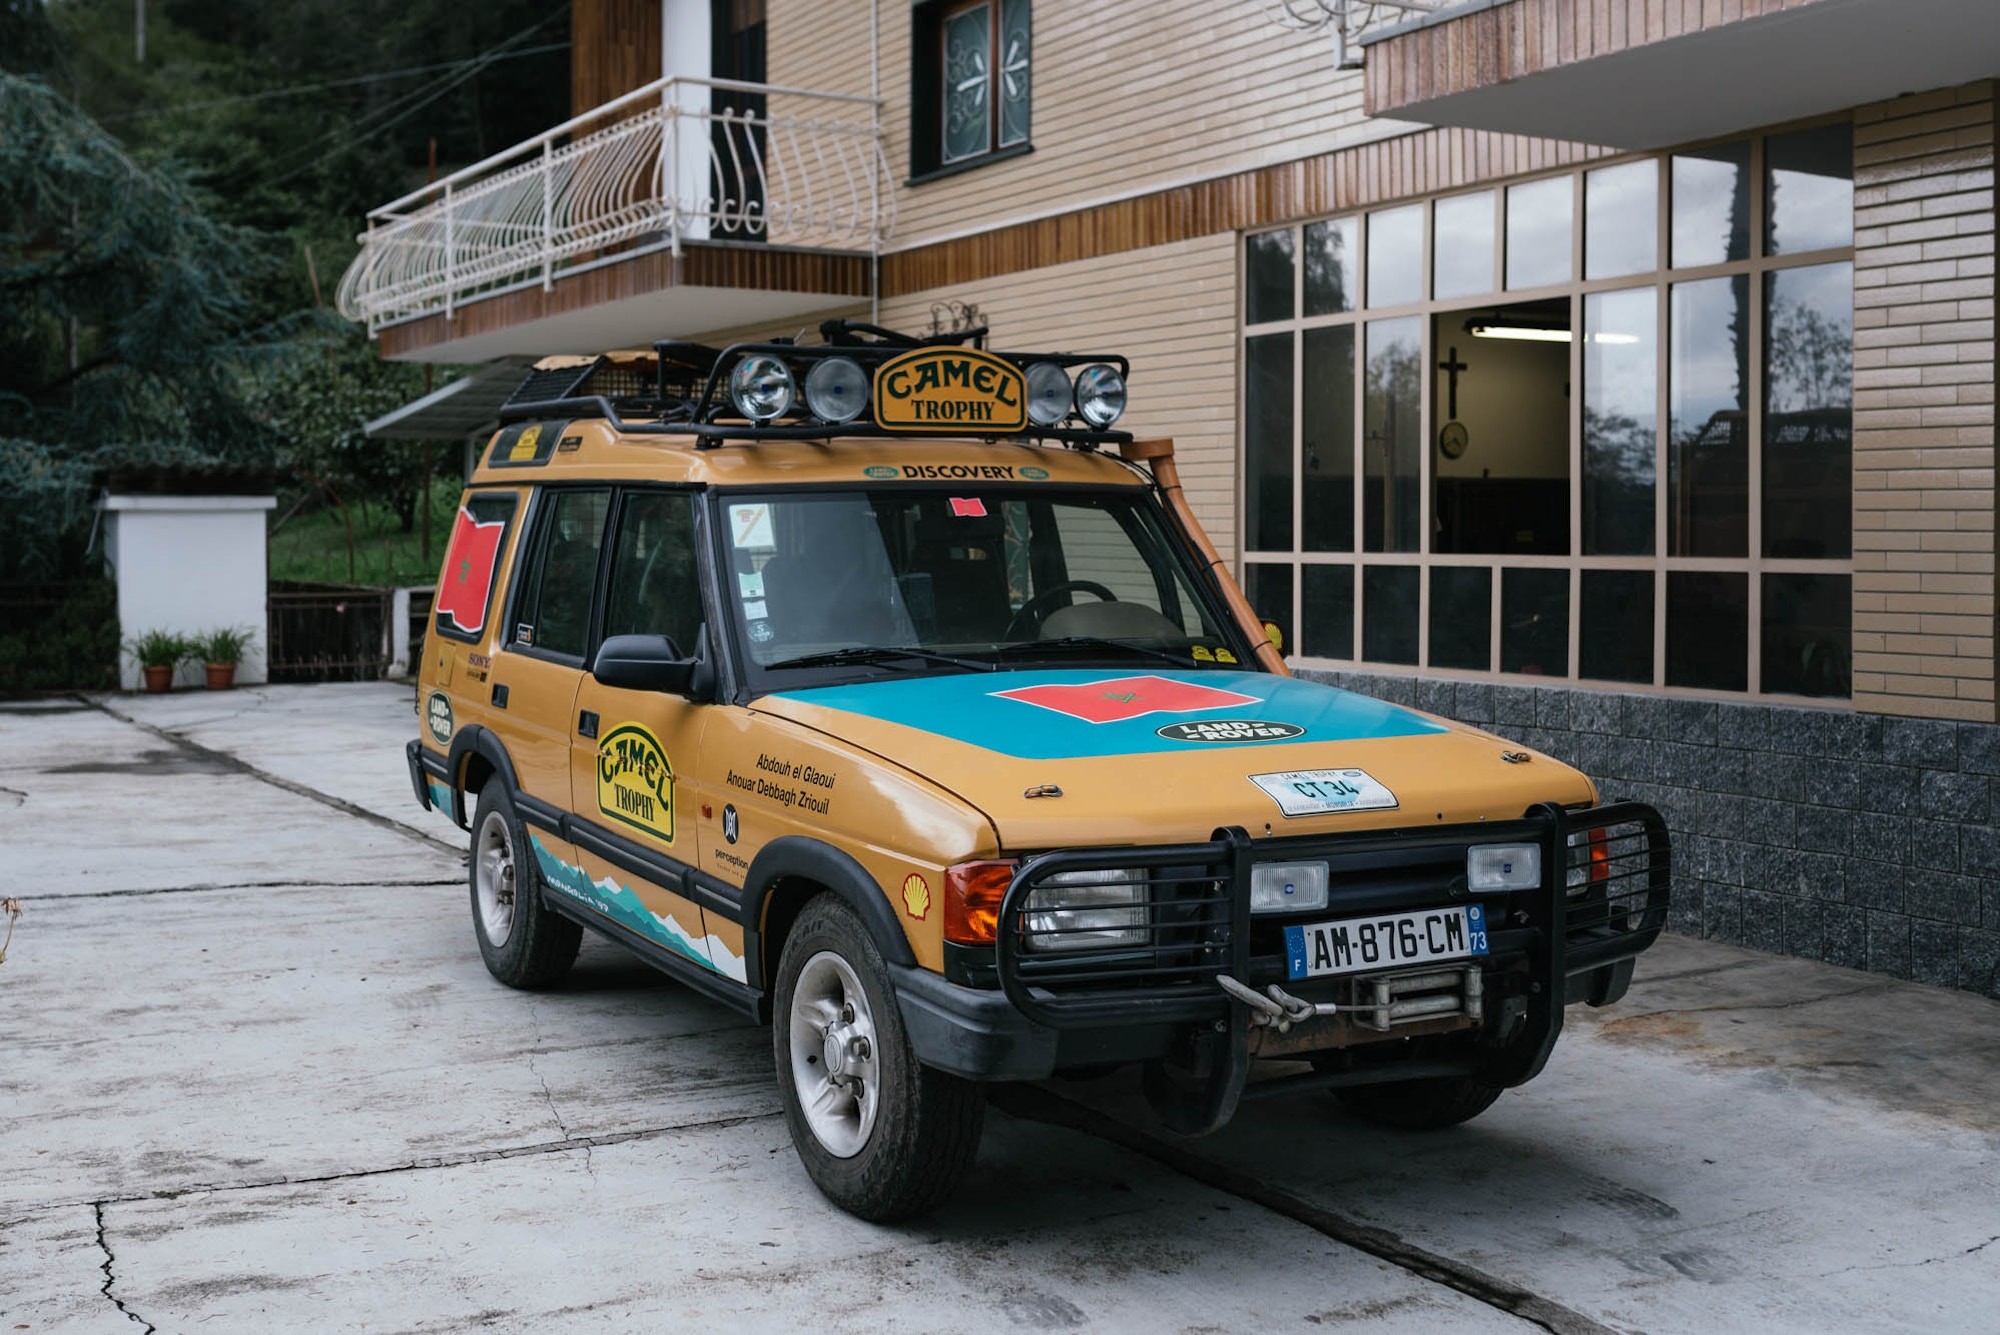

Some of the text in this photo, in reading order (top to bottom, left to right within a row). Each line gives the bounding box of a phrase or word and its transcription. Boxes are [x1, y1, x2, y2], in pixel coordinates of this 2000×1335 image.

[887, 360, 1017, 407] CAMEL
[911, 399, 995, 420] TROPHY
[902, 464, 1015, 479] DISCOVERY
[431, 697, 446, 717] LAND
[432, 715, 451, 737] ROVER
[1180, 722, 1250, 733] LAND
[1201, 727, 1292, 740] ROVER
[601, 738, 668, 811] CAMEL
[756, 753, 836, 789] Abdouh el Glaoui
[726, 769, 830, 815] Anouar Debbagh Zriouil
[1293, 779, 1360, 798] CT 34
[614, 782, 655, 822] TROPHY
[715, 848, 749, 870] perception
[1315, 913, 1465, 969] AM-876-CM
[1470, 931, 1487, 951] 73
[1294, 959, 1302, 971] F
